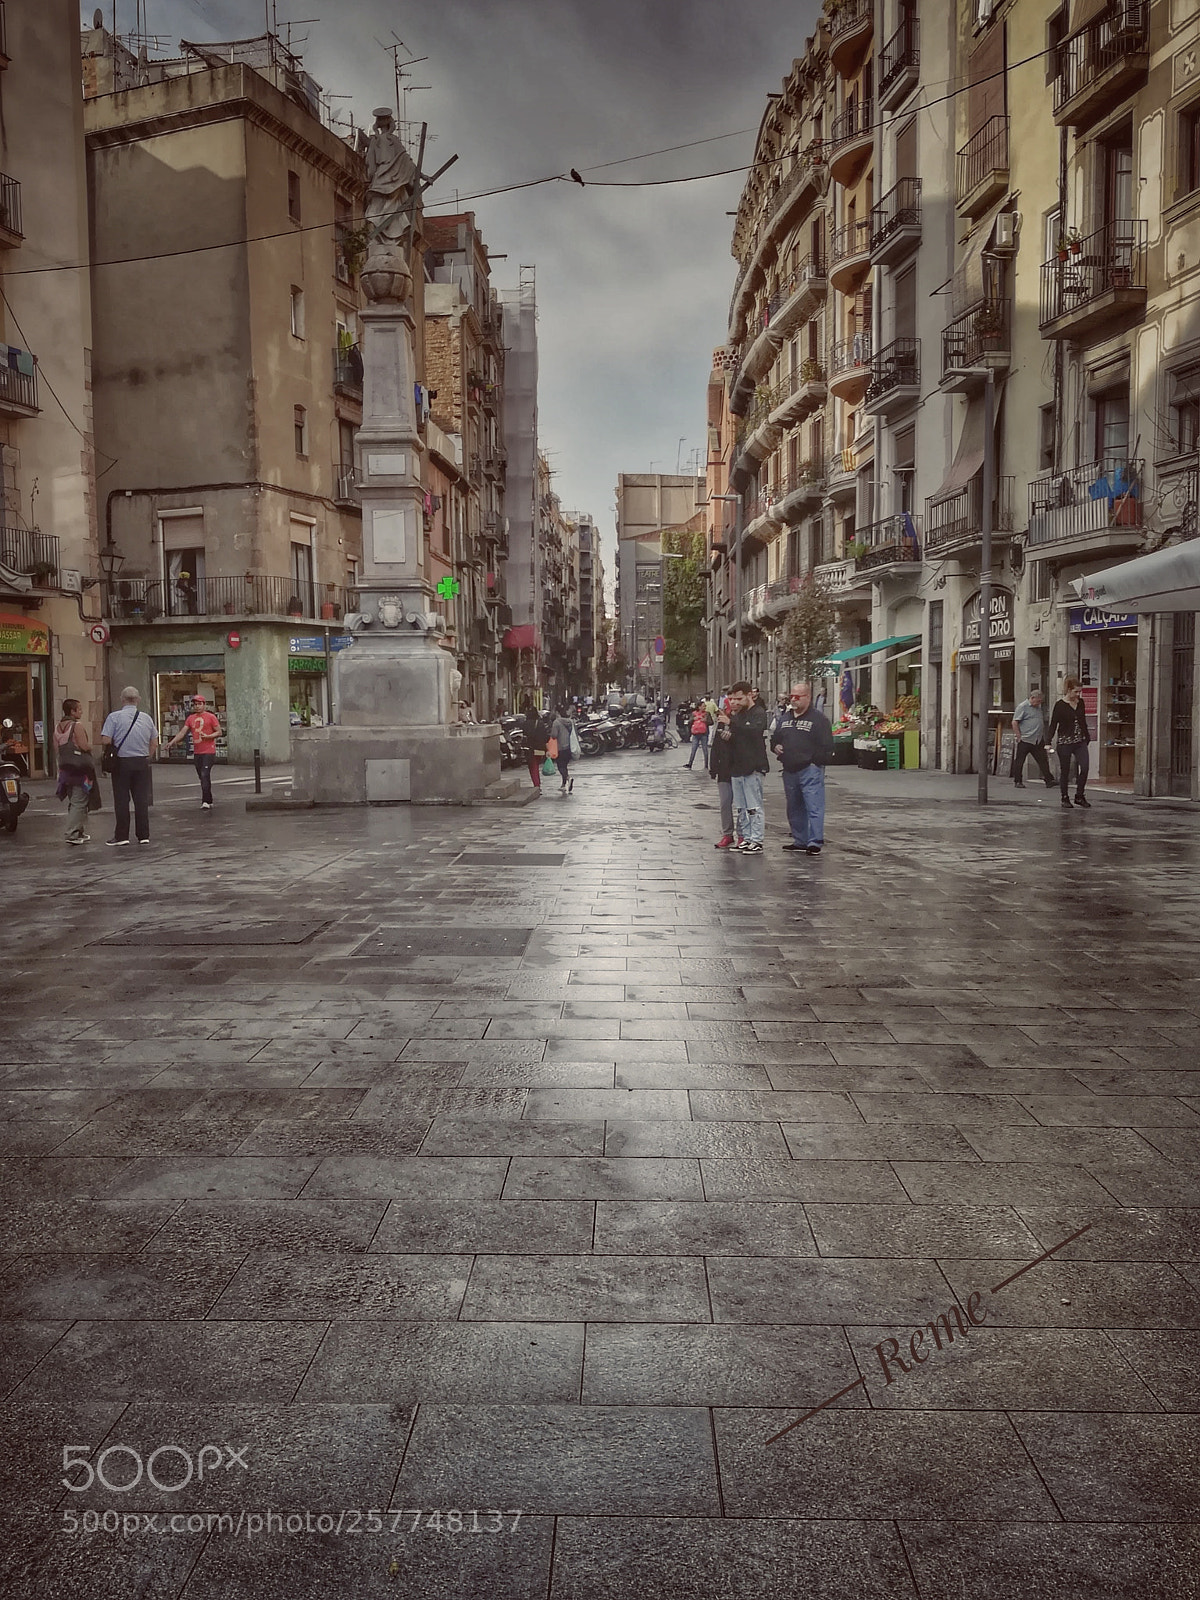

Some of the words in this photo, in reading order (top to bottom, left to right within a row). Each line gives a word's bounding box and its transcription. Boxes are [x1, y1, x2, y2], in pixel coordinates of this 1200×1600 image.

[966, 623, 980, 640] DEL
[959, 653, 980, 662] PANADERI
[289, 659, 326, 671] FARMACI
